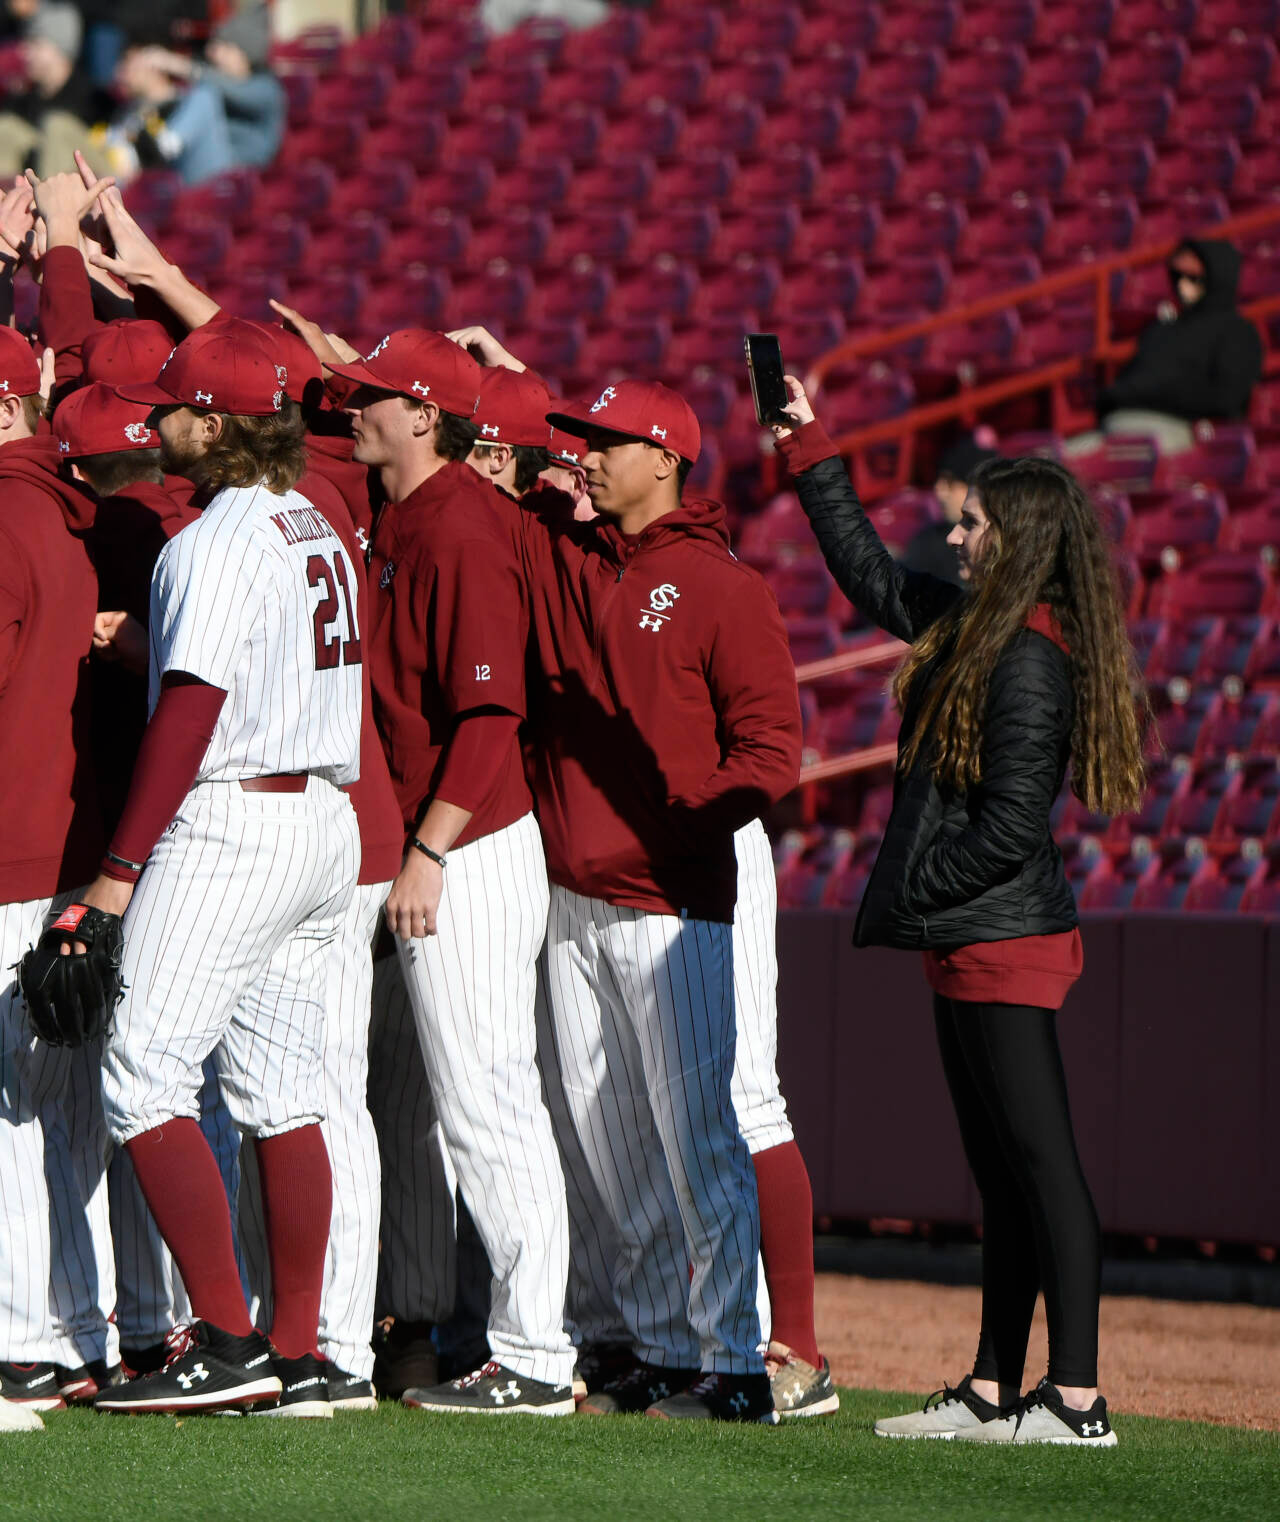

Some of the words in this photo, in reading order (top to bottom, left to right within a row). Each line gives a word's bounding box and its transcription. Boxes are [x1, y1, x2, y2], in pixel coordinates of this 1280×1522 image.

[305, 550, 363, 671] 21
[475, 664, 491, 681] 12
[287, 1376, 319, 1393] UNDER
